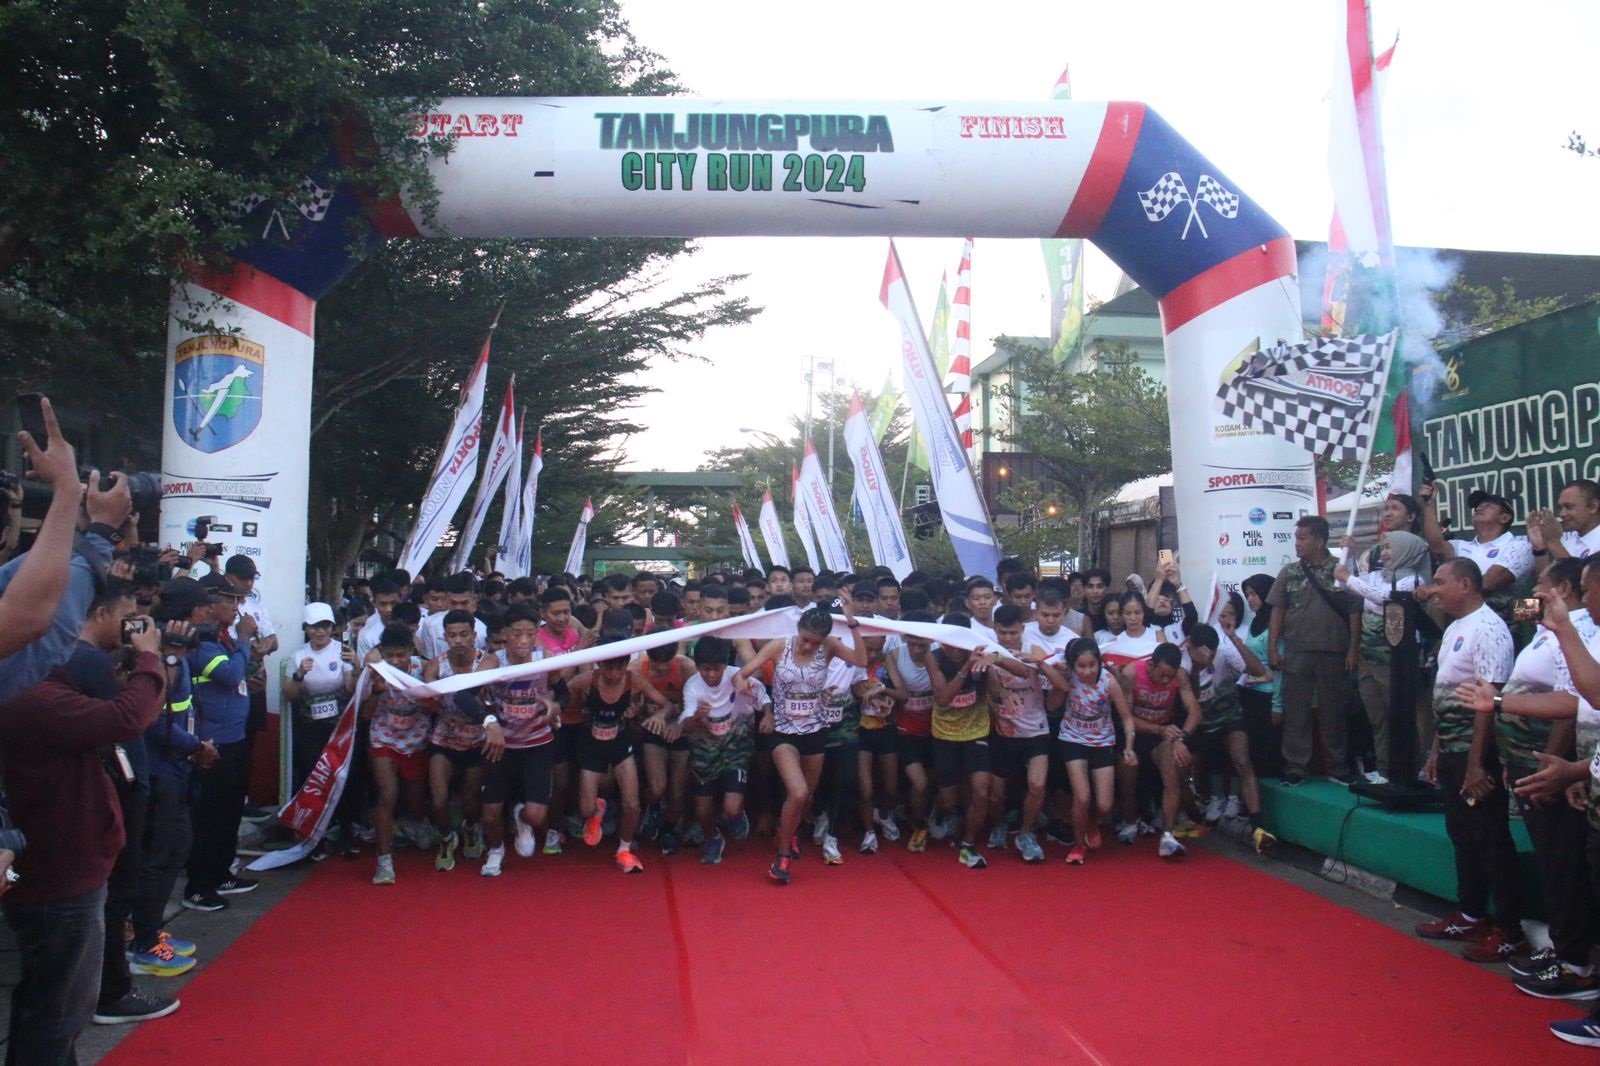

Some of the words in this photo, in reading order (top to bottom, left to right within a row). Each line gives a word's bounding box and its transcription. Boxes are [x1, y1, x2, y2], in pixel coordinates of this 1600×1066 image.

[407, 113, 523, 138] START
[594, 112, 895, 152] TANJUNGPURA
[959, 114, 1067, 139] FINISH
[621, 152, 697, 191] CITY
[707, 153, 772, 192] RUN
[783, 153, 866, 192] 2024
[1423, 390, 1570, 472] TANJUNG
[1573, 382, 1600, 448] P
[1208, 473, 1257, 488] SPORTA
[164, 483, 193, 494] SPORTA
[194, 482, 265, 495] INDONESIA
[1503, 458, 1577, 526] RUN
[1243, 530, 1262, 539] Milk
[246, 547, 261, 556] BRI
[312, 703, 335, 714] 8203
[790, 701, 814, 711] 8153
[738, 768, 747, 783] 13
